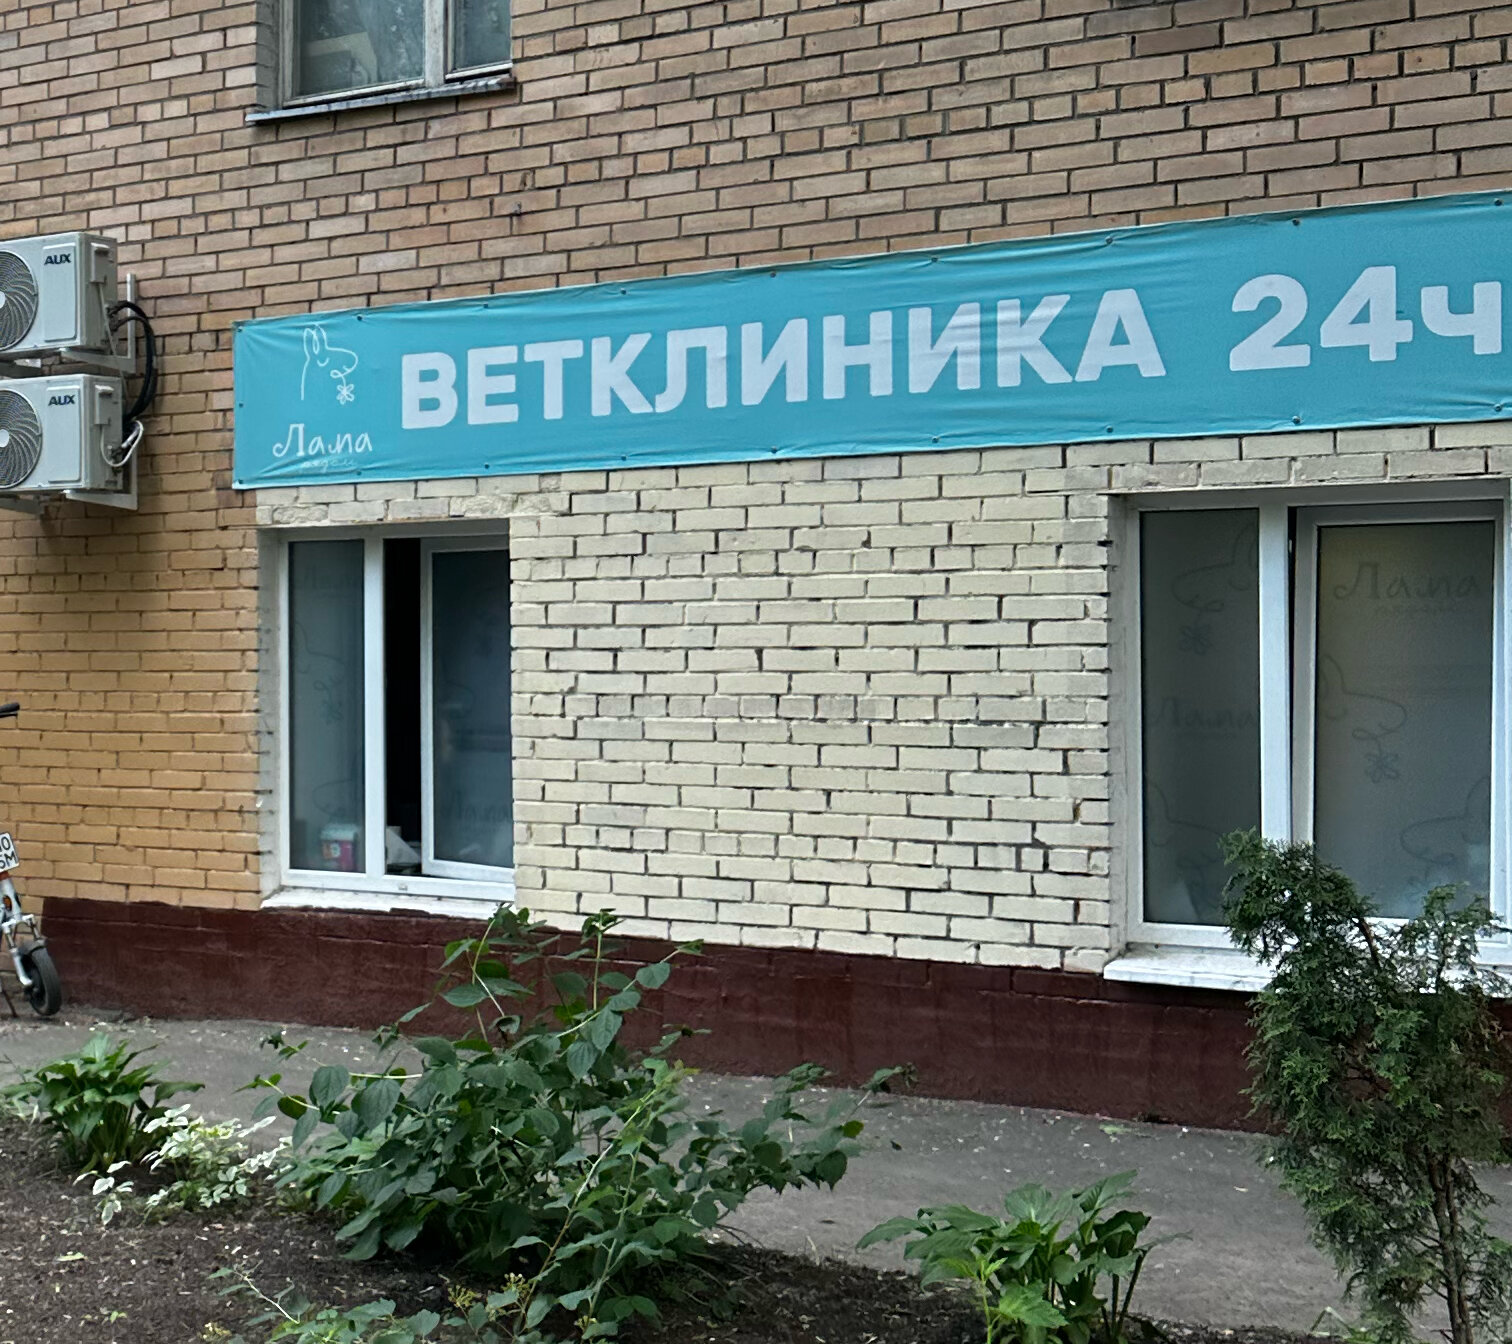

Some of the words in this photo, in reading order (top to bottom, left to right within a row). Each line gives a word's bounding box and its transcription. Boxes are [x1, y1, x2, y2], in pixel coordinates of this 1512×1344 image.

[44, 253, 72, 266] AUX
[400, 288, 1167, 431] ВЕТКЛИНИКА
[1229, 265, 1502, 371] 24ч
[48, 394, 76, 406] AUX
